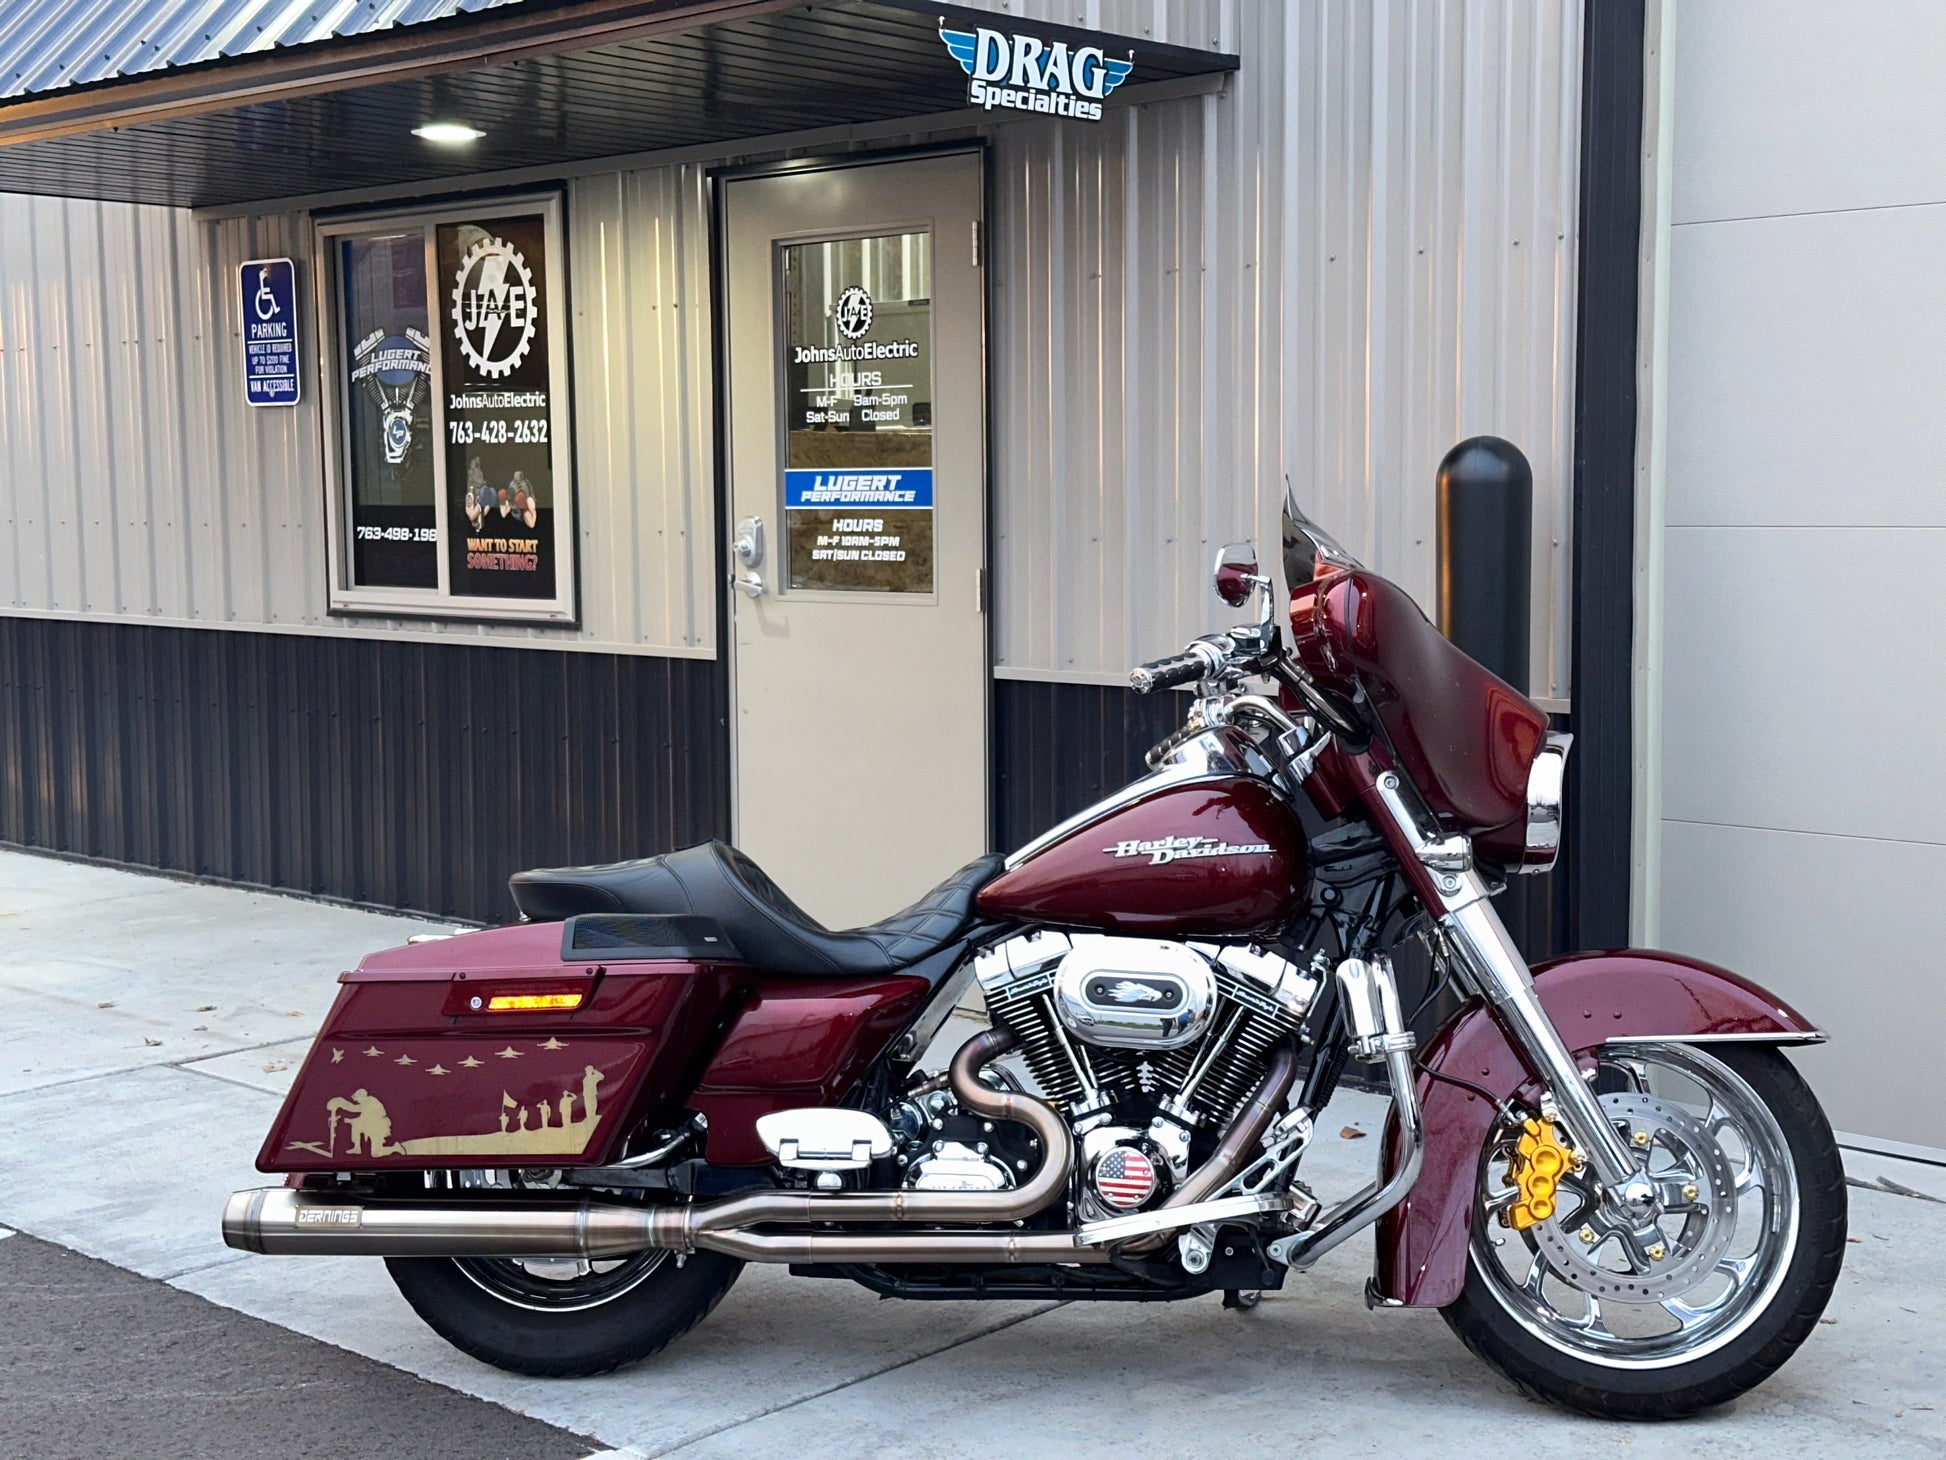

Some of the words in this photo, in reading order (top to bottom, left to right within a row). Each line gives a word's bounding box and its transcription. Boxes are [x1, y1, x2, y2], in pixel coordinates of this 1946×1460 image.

[973, 28, 1107, 99] DRAG
[970, 79, 1103, 121] Specialties
[251, 322, 287, 339] PARKING
[371, 348, 421, 363] LUGERT
[794, 339, 919, 364] JohnsAutoElectric
[250, 381, 262, 393] VAN
[263, 379, 294, 392] ACCESSIBLE
[829, 371, 882, 388] HOURS
[450, 391, 546, 410] JohnsAutoElectric
[816, 396, 838, 408] M-F
[806, 410, 850, 424] Sat-Sun
[861, 408, 900, 421] Closed
[450, 419, 548, 444] 763-428-2632
[813, 474, 902, 491] LUGERT
[800, 490, 916, 503] PERFORMANCE
[832, 518, 884, 532] HOURS
[467, 538, 494, 552] WANT
[494, 538, 507, 552] TO
[508, 539, 538, 554] START
[816, 535, 840, 546] M-F
[841, 536, 900, 547] 10AM-5PM
[467, 552, 538, 571] SOMETHING?
[860, 551, 906, 562] CLOSED
[1108, 835, 1212, 858] Harley
[1145, 842, 1274, 865] Davidson
